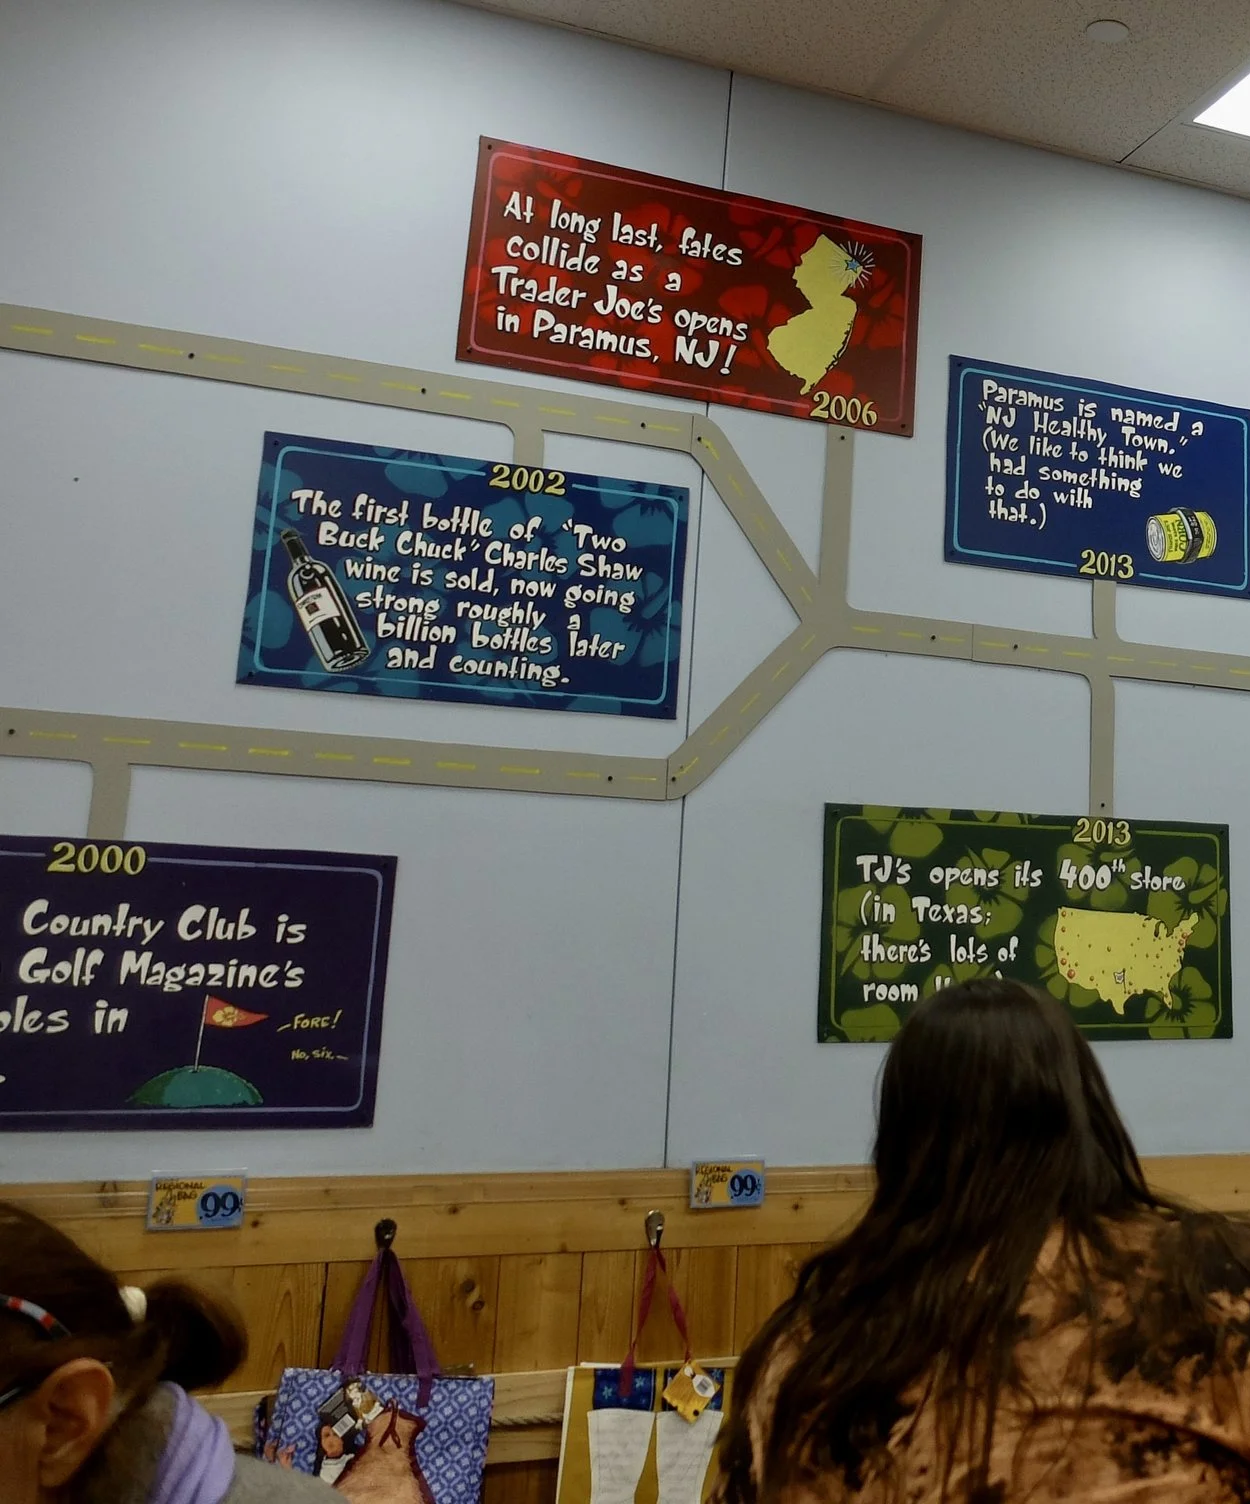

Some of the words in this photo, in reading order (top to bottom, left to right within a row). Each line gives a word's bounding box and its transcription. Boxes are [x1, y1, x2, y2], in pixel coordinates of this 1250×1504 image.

[503, 190, 534, 224] At
[550, 198, 602, 244] long
[612, 211, 663, 253] last,
[678, 226, 743, 266] fates
[506, 235, 601, 275] collide
[611, 259, 644, 282] as
[664, 272, 682, 292] a
[491, 265, 587, 309] Trader
[593, 284, 663, 324] Joe's
[674, 309, 748, 341] opens
[496, 305, 520, 333] in
[533, 308, 659, 363] Paramus,
[809, 391, 877, 426] 2006
[982, 379, 1064, 412] Paramus
[1078, 398, 1098, 418] is
[1110, 407, 1180, 432] named
[1191, 421, 1204, 436] a
[1033, 410, 1107, 448] Healthy
[982, 425, 1019, 452] (We
[1029, 435, 1063, 458] like
[1069, 441, 1089, 462] to
[1097, 446, 1148, 472] think
[1158, 462, 1183, 479] we
[990, 452, 1026, 476] had
[1038, 466, 1143, 498] something
[489, 463, 566, 495] 2002
[984, 475, 1005, 496] to
[1014, 480, 1040, 500] do
[1053, 486, 1093, 509] with
[291, 489, 342, 518] The
[351, 493, 409, 527] first
[422, 502, 493, 537] bottle
[509, 516, 543, 542] of
[318, 521, 385, 551] Buck
[484, 540, 568, 574] Charles
[577, 553, 643, 580] Shaw
[1079, 549, 1134, 579] 2013
[345, 558, 401, 583] wine
[411, 562, 433, 586] is
[445, 567, 499, 597] sold,
[510, 578, 557, 598] now
[563, 584, 635, 614] going
[355, 584, 440, 621] strong
[457, 601, 547, 631] roughly
[566, 613, 581, 630] a
[377, 612, 456, 644] billion
[472, 621, 552, 654] bottles
[569, 630, 626, 659] later
[387, 644, 437, 669] and
[449, 655, 570, 687] counting.
[1073, 817, 1131, 845] 2013
[47, 842, 146, 875] 2000
[856, 855, 912, 885] TJ's
[929, 866, 999, 891] opens
[1015, 860, 1043, 887] its
[1130, 866, 1187, 892] store
[22, 899, 165, 945] Country
[177, 904, 257, 941] Club
[275, 913, 307, 944] is
[860, 890, 896, 926] (in
[911, 896, 992, 925] Texas;
[18, 946, 105, 987] Golf
[119, 950, 305, 992] Magazine's
[860, 933, 932, 963] there's
[950, 933, 988, 963] lots
[997, 936, 1019, 962] of
[863, 982, 919, 1002] room
[94, 999, 129, 1034] in
